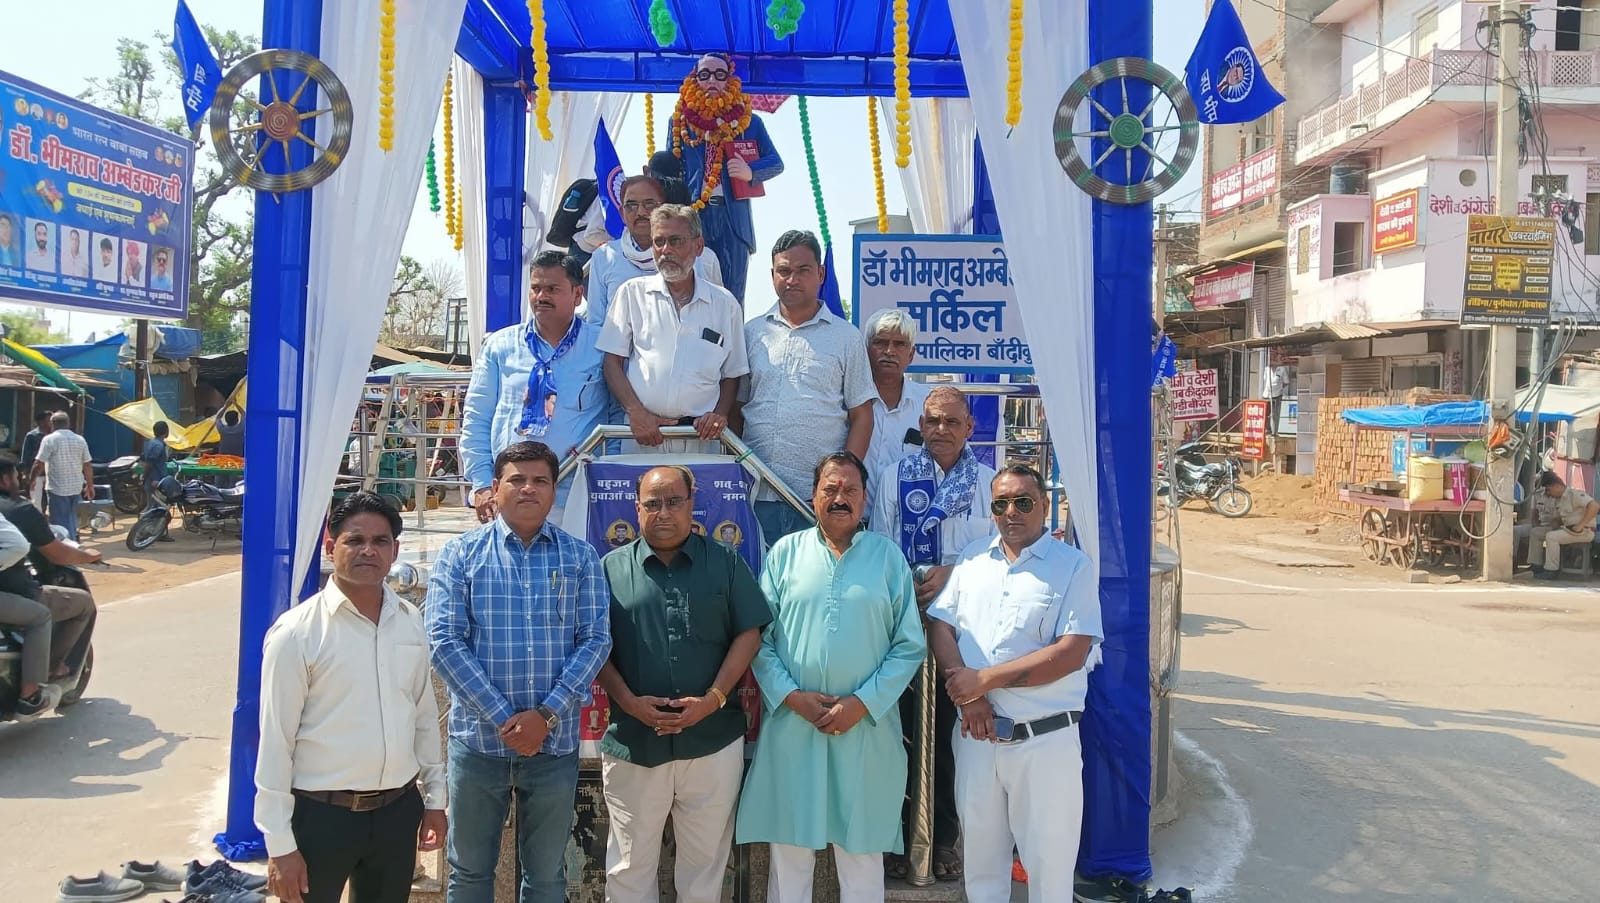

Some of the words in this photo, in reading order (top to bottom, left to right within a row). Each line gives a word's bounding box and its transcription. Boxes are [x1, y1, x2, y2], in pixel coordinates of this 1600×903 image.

[9, 122, 38, 164] डॉ.
[41, 134, 101, 182] भीमराव
[101, 157, 164, 200] अम्बेडकर
[162, 172, 182, 205] जी
[1429, 194, 1453, 215] देशी
[862, 248, 888, 287] डॉ
[889, 246, 964, 288] भीमराव
[964, 247, 1014, 288] अम्बे
[897, 289, 1006, 333] सर्किल
[1187, 374, 1193, 385] व
[1194, 370, 1216, 386] देशी
[1195, 385, 1217, 400] दुकान
[597, 479, 630, 490] बहुजन
[722, 493, 746, 501] नमन
